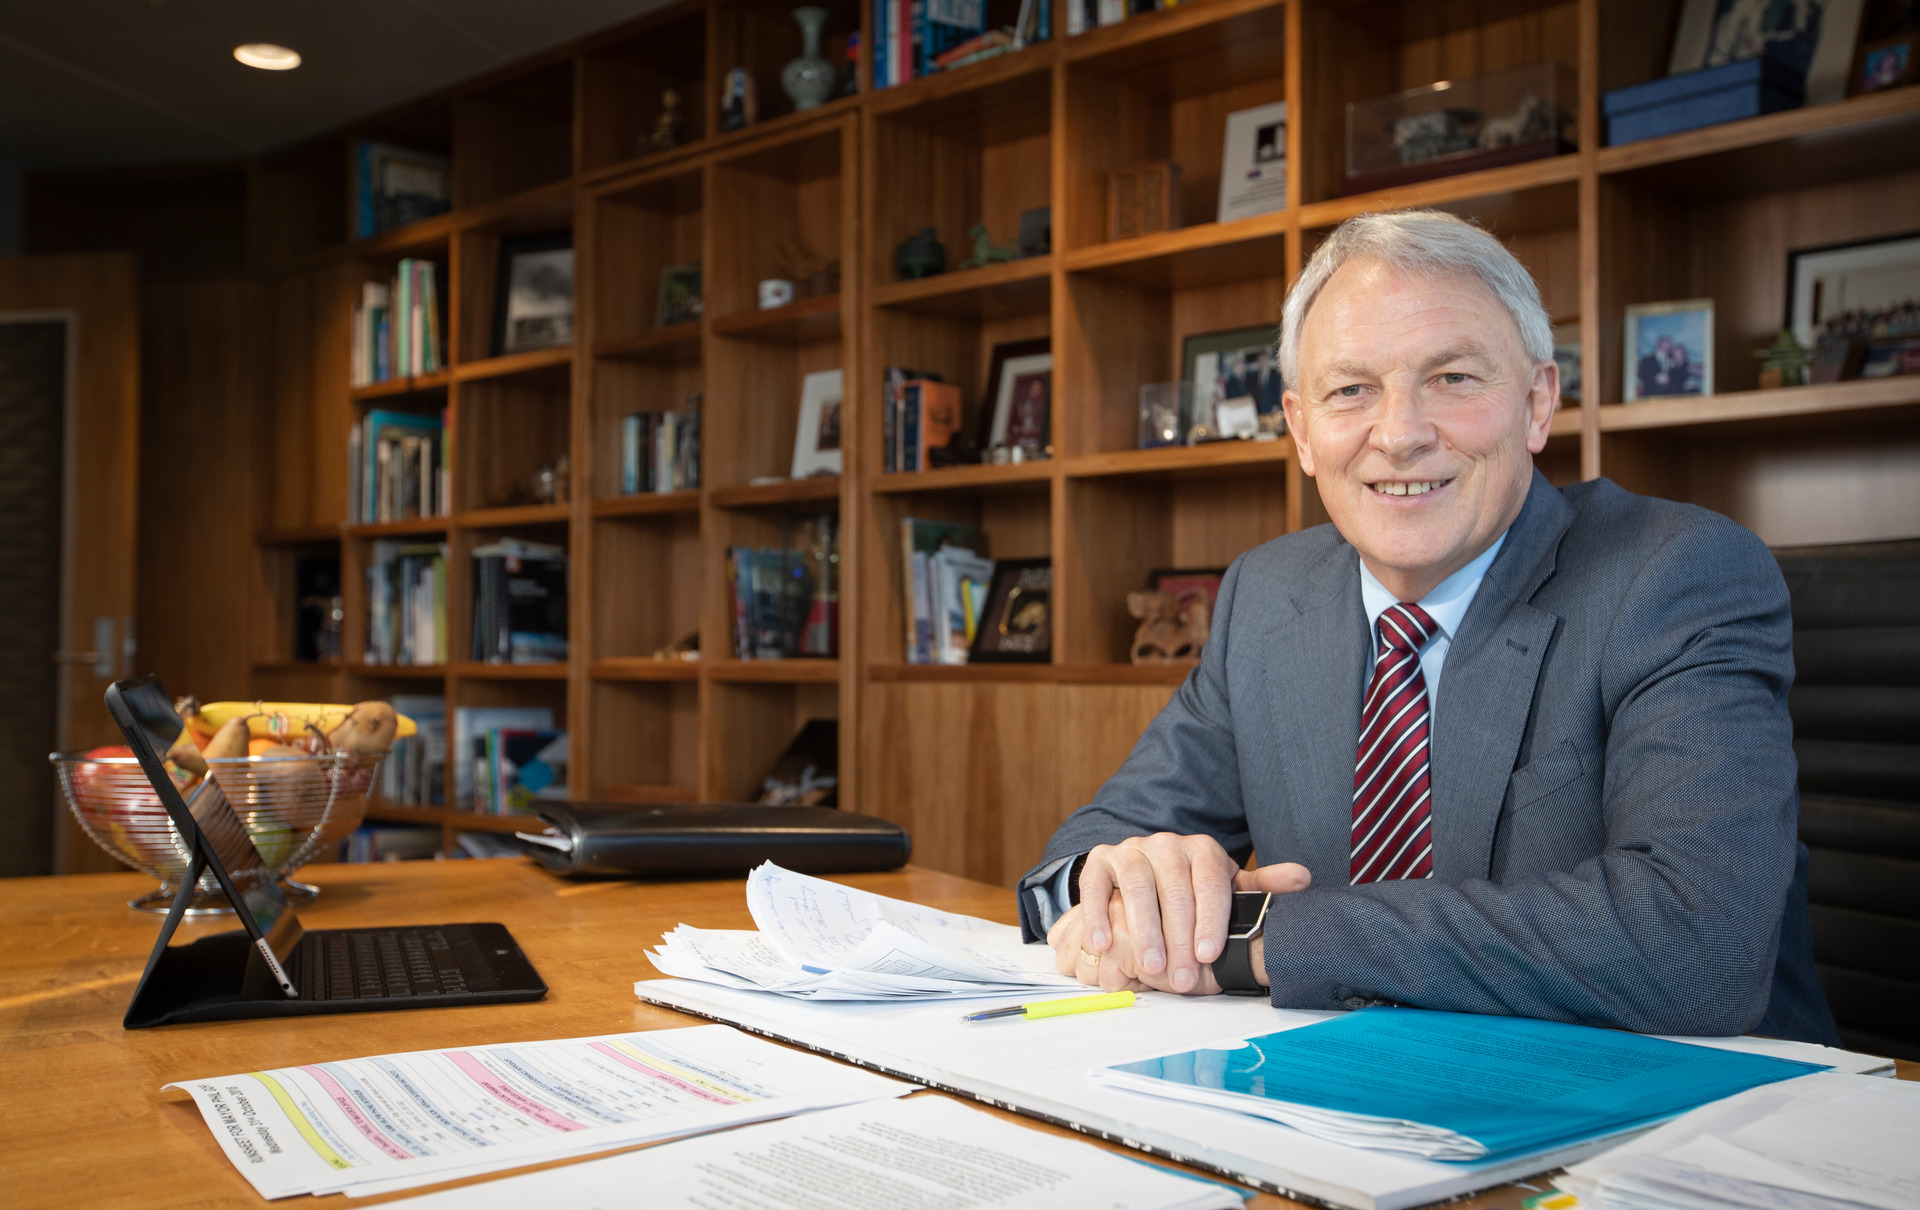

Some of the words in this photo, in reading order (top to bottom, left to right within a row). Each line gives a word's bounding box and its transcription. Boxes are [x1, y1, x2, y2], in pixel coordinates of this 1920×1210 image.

[207, 1091, 226, 1103] PHIL
[236, 1096, 257, 1116] October
[214, 1103, 238, 1125] MAYOR
[227, 1124, 246, 1137] FOR
[257, 1127, 283, 1154] Wednesday
[234, 1137, 265, 1164] RUNSHEET
